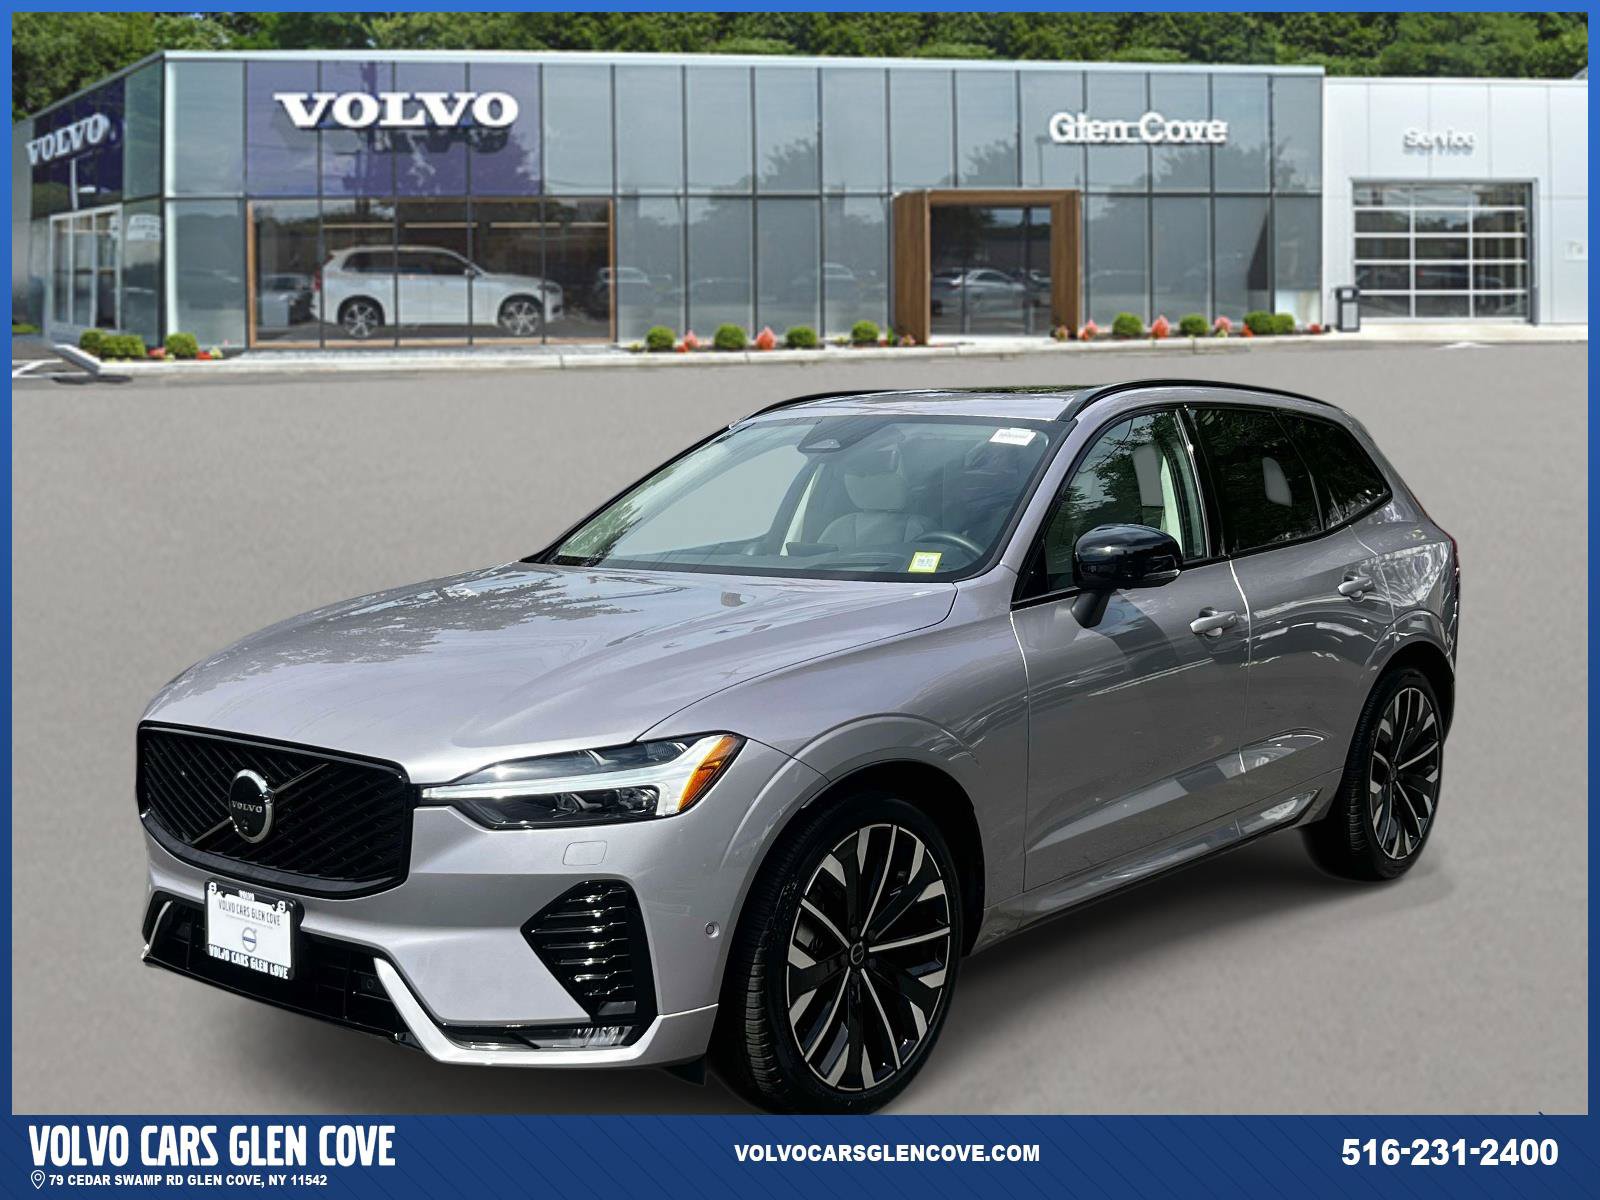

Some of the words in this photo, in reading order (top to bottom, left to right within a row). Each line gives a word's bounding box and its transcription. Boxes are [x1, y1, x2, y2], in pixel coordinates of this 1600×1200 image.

[274, 92, 520, 128] VOLVO
[25, 112, 110, 166] VOLVO
[1049, 111, 1131, 144] Glen
[1139, 111, 1228, 144] Cove
[1402, 128, 1476, 151] Service
[232, 800, 263, 814] VOLVO
[208, 944, 230, 962] VOLVO
[230, 951, 249, 968] CARS
